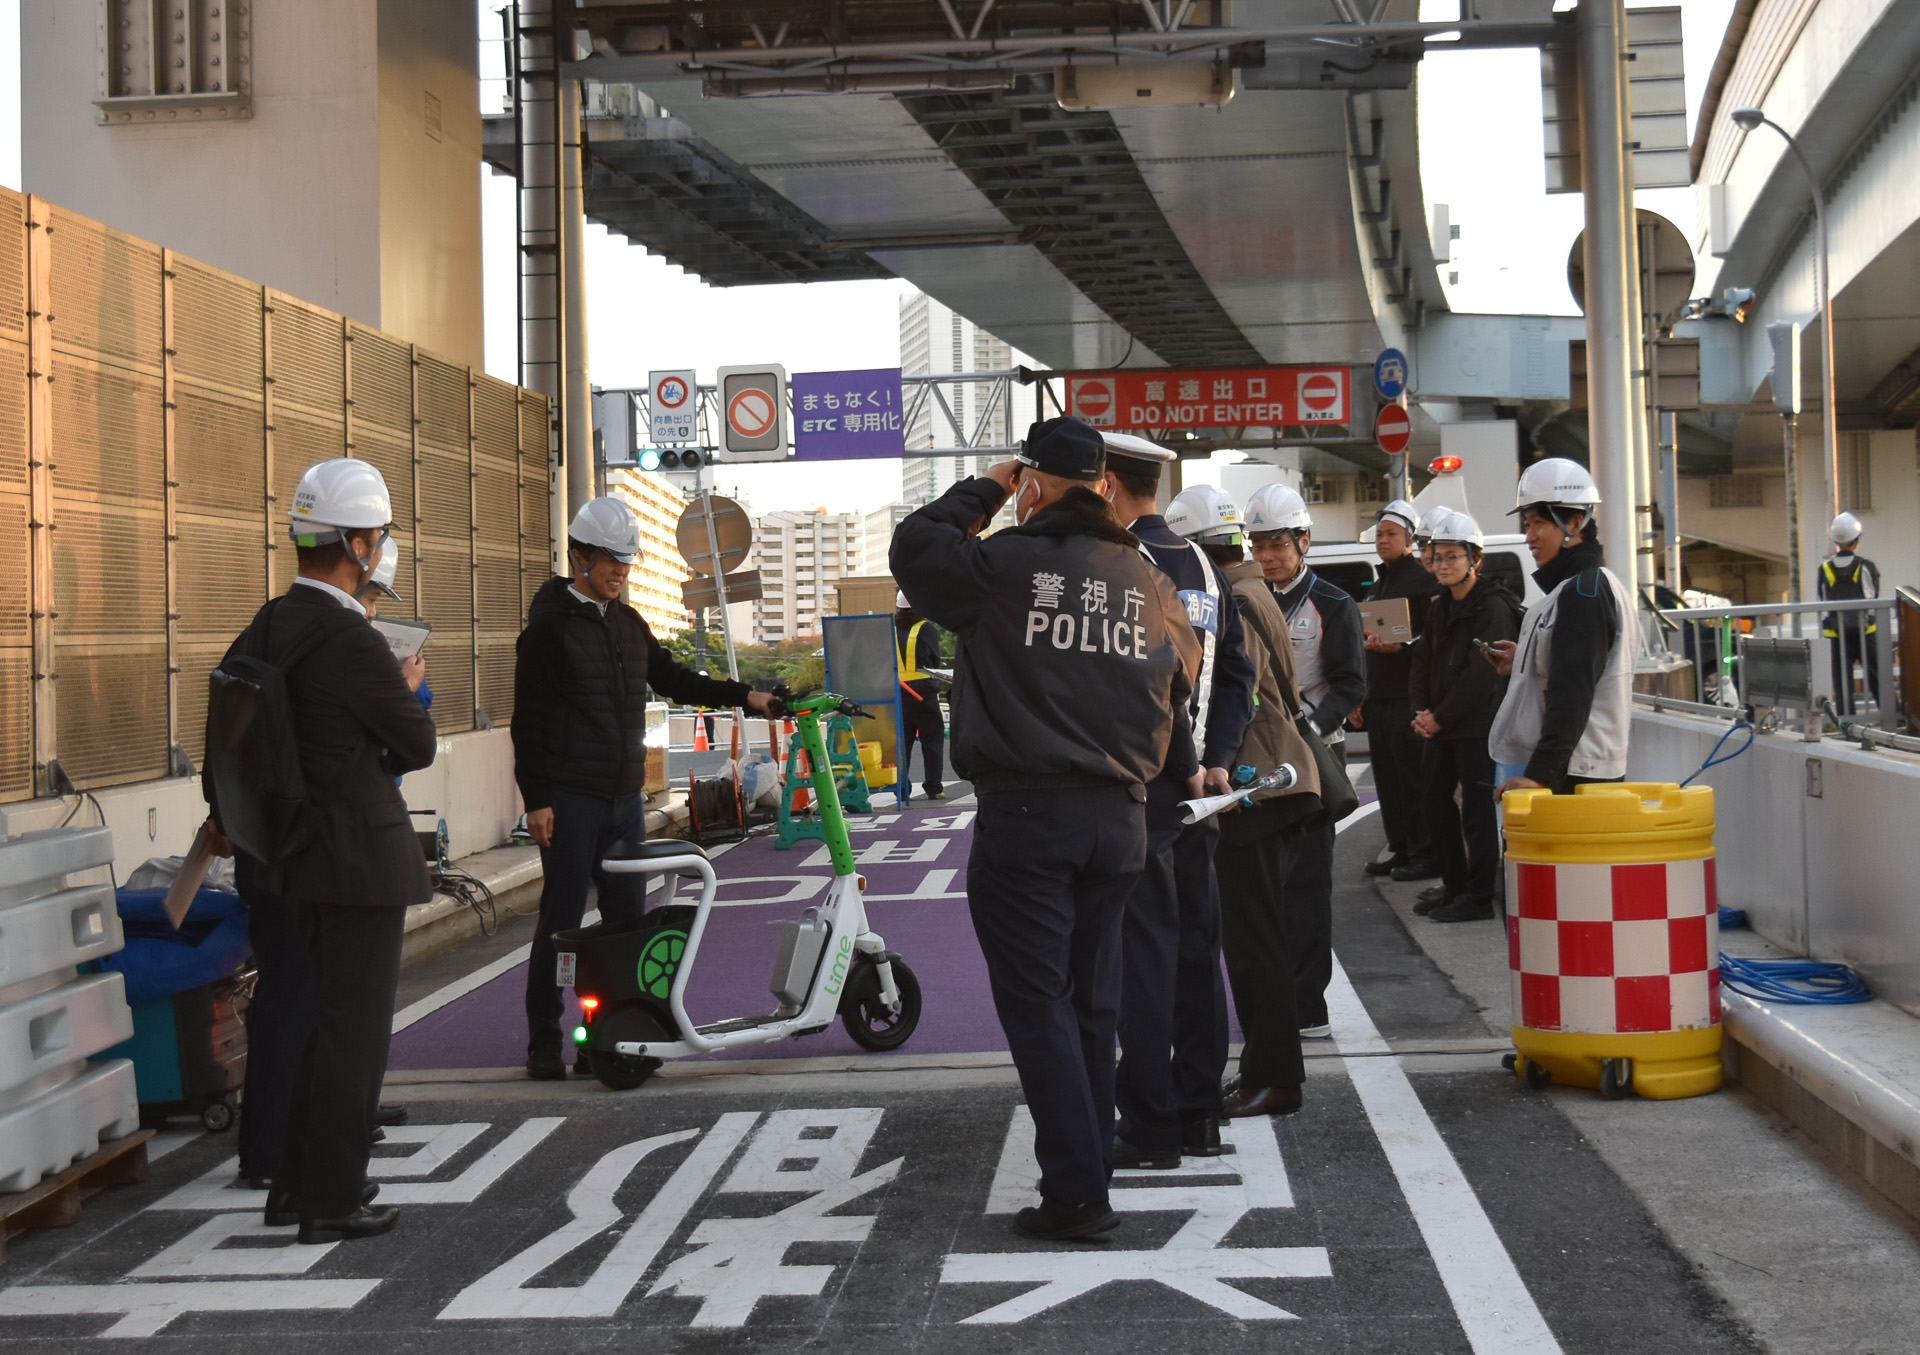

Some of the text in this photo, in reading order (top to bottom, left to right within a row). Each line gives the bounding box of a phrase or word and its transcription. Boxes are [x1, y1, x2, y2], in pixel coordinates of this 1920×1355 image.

[802, 389, 892, 411] まもなく!
[1144, 378, 1268, 402] 高速出口
[654, 414, 693, 425] 向島出口
[802, 411, 901, 433] ETC 専用化
[1130, 402, 1283, 425] DO NOT ENTER
[1031, 571, 1146, 622] 警視庁
[1186, 593, 1215, 625] 視庁
[1025, 611, 1148, 660] POLICE
